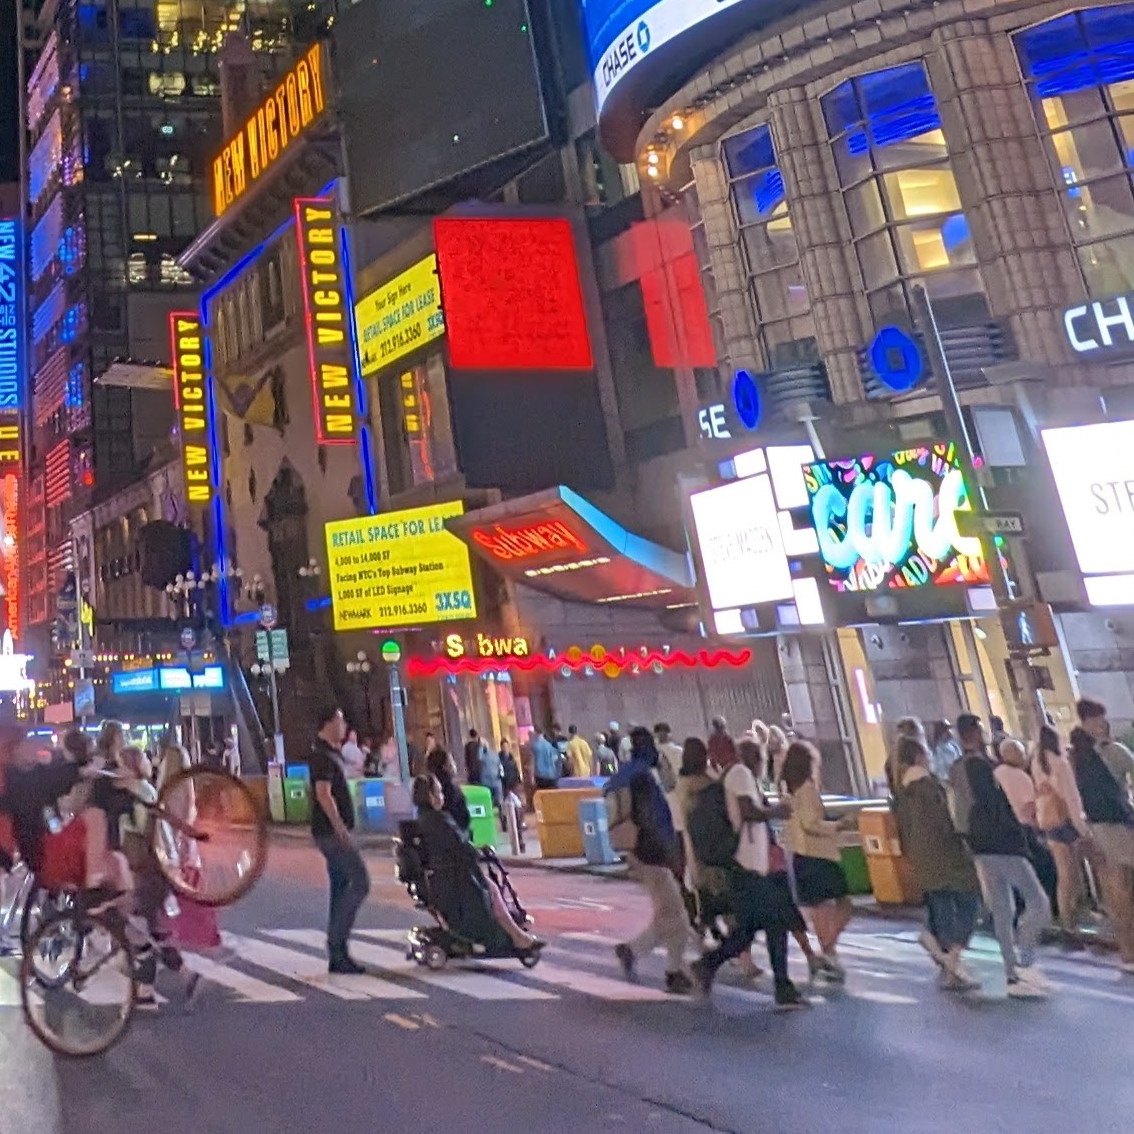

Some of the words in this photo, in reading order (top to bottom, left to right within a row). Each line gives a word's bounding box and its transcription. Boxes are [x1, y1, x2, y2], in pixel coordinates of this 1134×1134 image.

[602, 33, 637, 87] CHASE
[213, 130, 246, 216] NEW
[247, 43, 324, 179] VICTORY
[306, 207, 344, 344] VICTORY
[401, 300, 414, 321] FOR
[415, 287, 435, 312] LEASE
[1065, 296, 1134, 353] CH
[178, 319, 205, 431] VICTORY
[320, 364, 353, 432] NEW
[185, 446, 210, 501] NEW
[332, 529, 365, 548] RETAIL
[368, 523, 400, 542] SPACE
[403, 520, 424, 536] FOR
[429, 516, 448, 533] LEA
[472, 521, 587, 559] Subway
[336, 572, 357, 584] Facing
[358, 569, 377, 580] NYC's
[378, 567, 391, 579] Top
[392, 564, 417, 577] Subway
[419, 561, 444, 572] Station
[353, 554, 359, 564] to
[382, 550, 390, 560] SF
[355, 588, 363, 598] SF
[364, 587, 371, 596] of
[372, 585, 386, 596] LED
[387, 584, 414, 596] Signage
[379, 602, 428, 618] 212.916.3360
[445, 633, 529, 658] Sbwa
